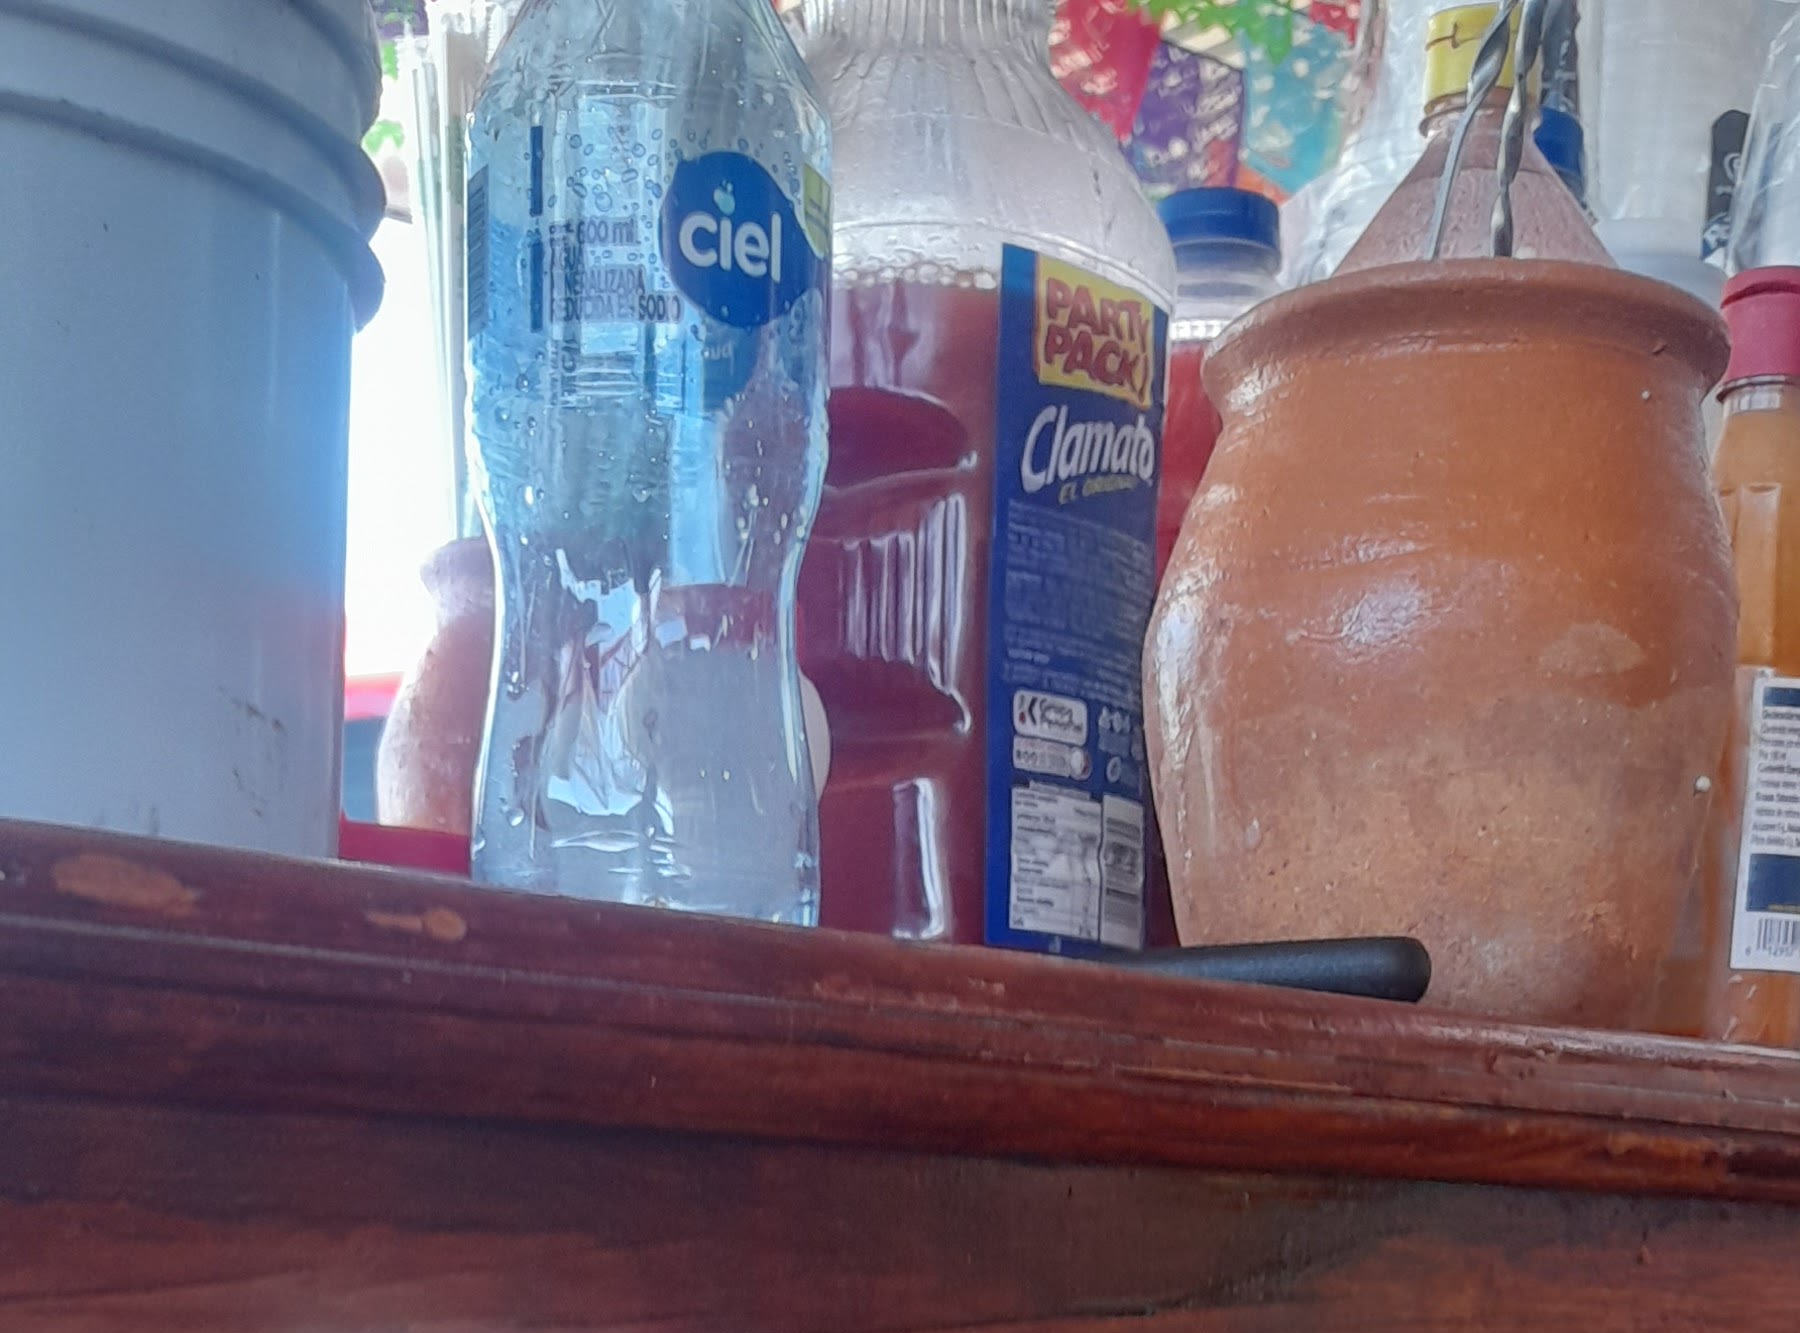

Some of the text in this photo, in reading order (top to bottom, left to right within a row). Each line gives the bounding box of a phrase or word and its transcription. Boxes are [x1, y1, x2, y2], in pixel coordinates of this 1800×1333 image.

[679, 212, 782, 283] ciel
[1046, 277, 1150, 353] PARTY
[1021, 405, 1155, 492] Clamato
